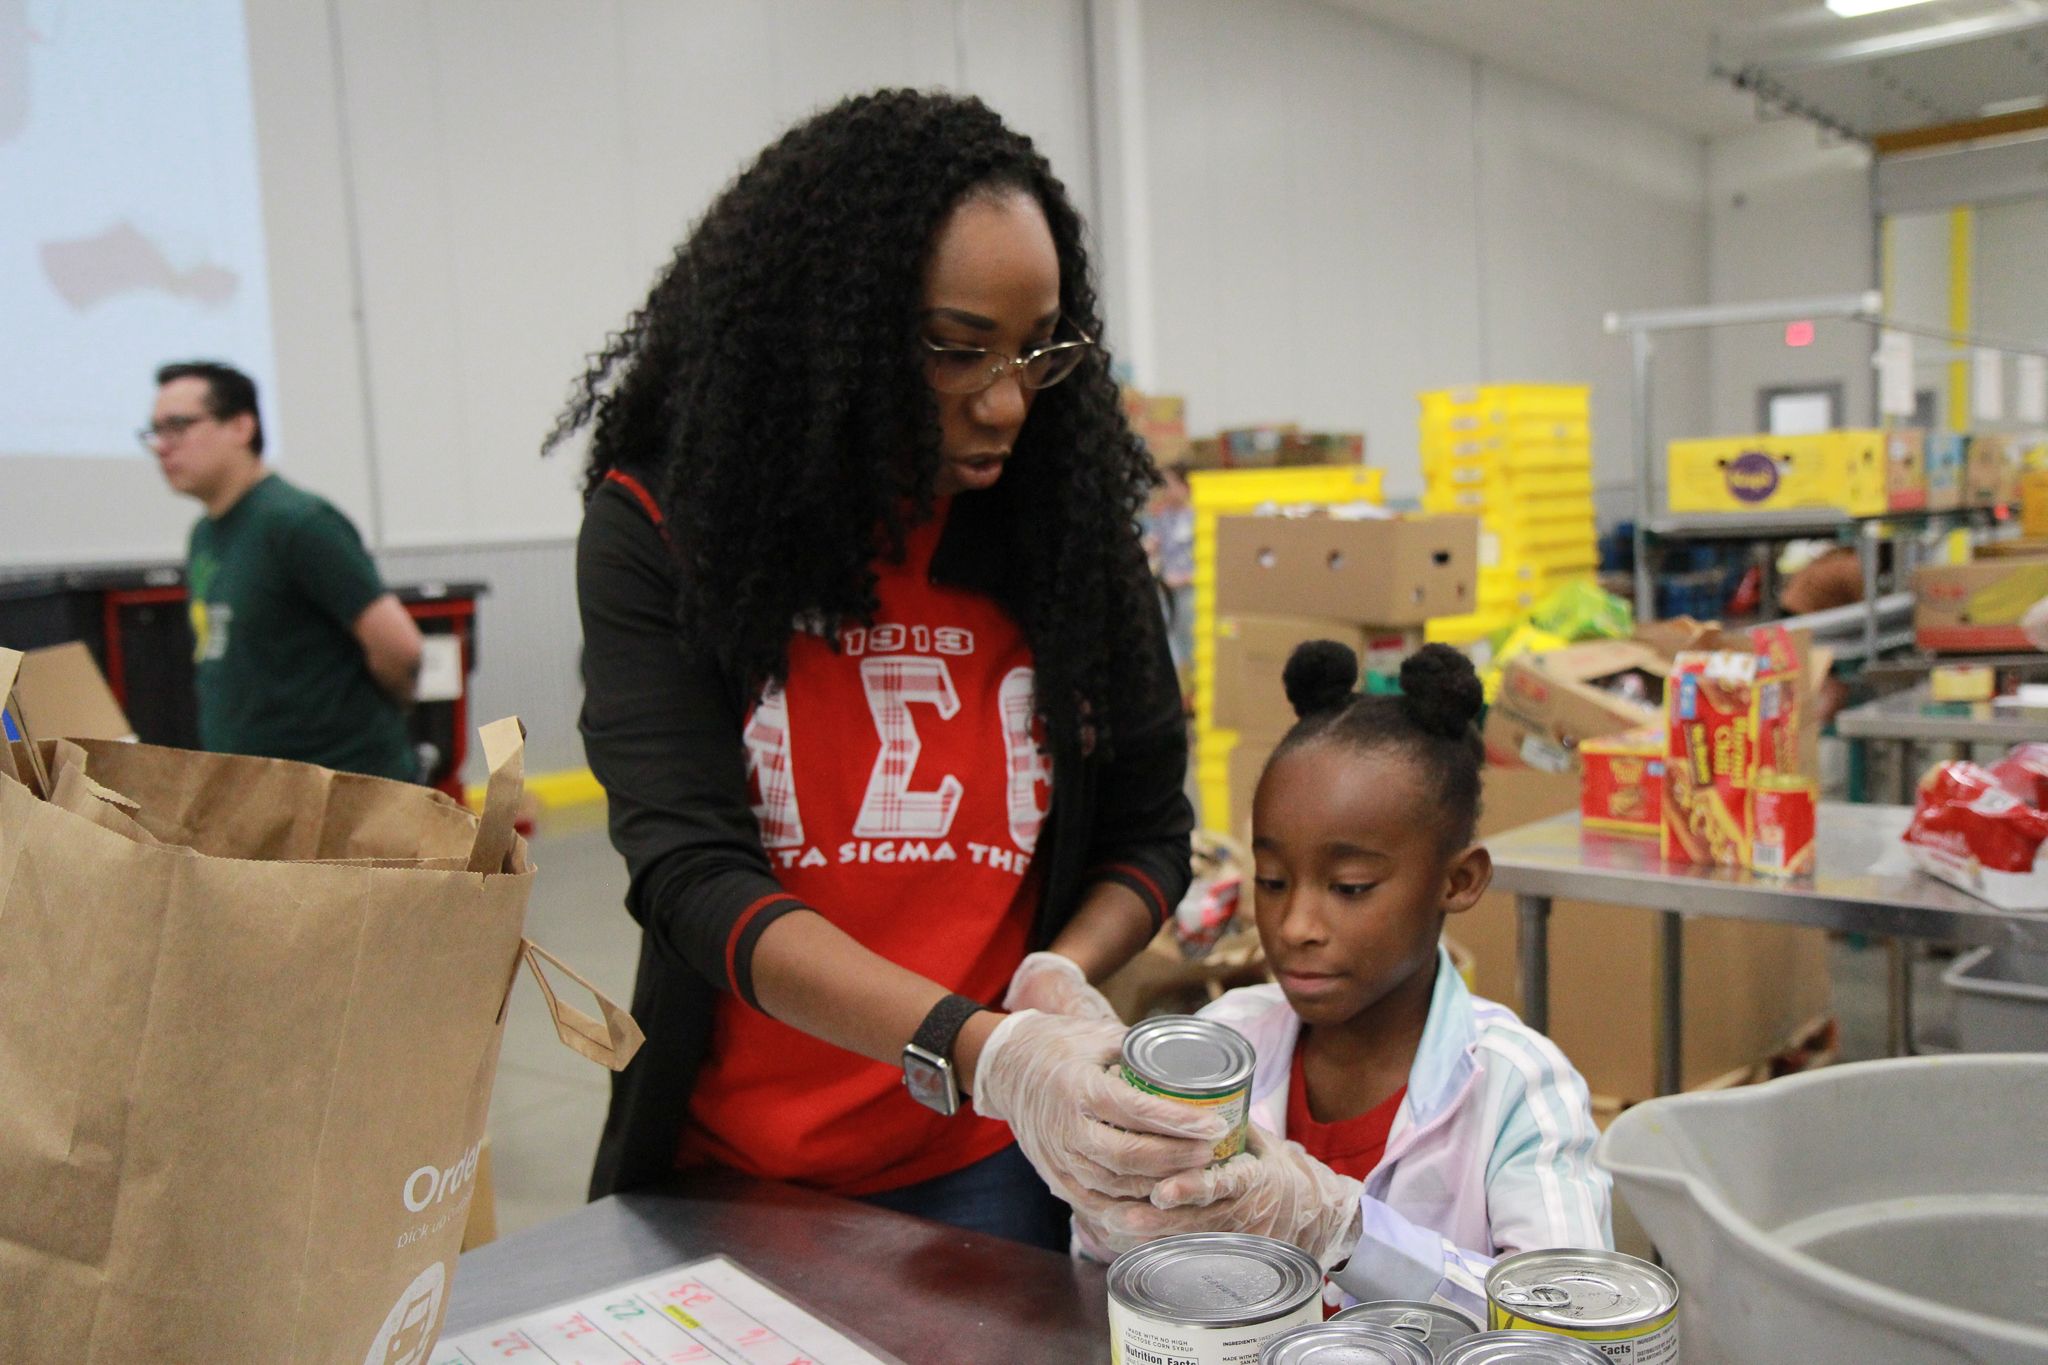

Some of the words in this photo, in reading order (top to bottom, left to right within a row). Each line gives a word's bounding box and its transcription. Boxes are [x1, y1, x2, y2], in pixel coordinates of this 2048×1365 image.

[844, 623, 974, 655] 1913
[838, 841, 957, 864] SIGMA
[1125, 1331, 1152, 1346] FRUCTOSE
[1152, 1341, 1171, 1350] CORN
[1128, 1327, 1142, 1337] MADE
[1143, 1331, 1159, 1341] WITH
[1160, 1336, 1170, 1344] NO
[1222, 1338, 1258, 1347] INGREDIENTS:
[1125, 1343, 1163, 1365] Nutrition
